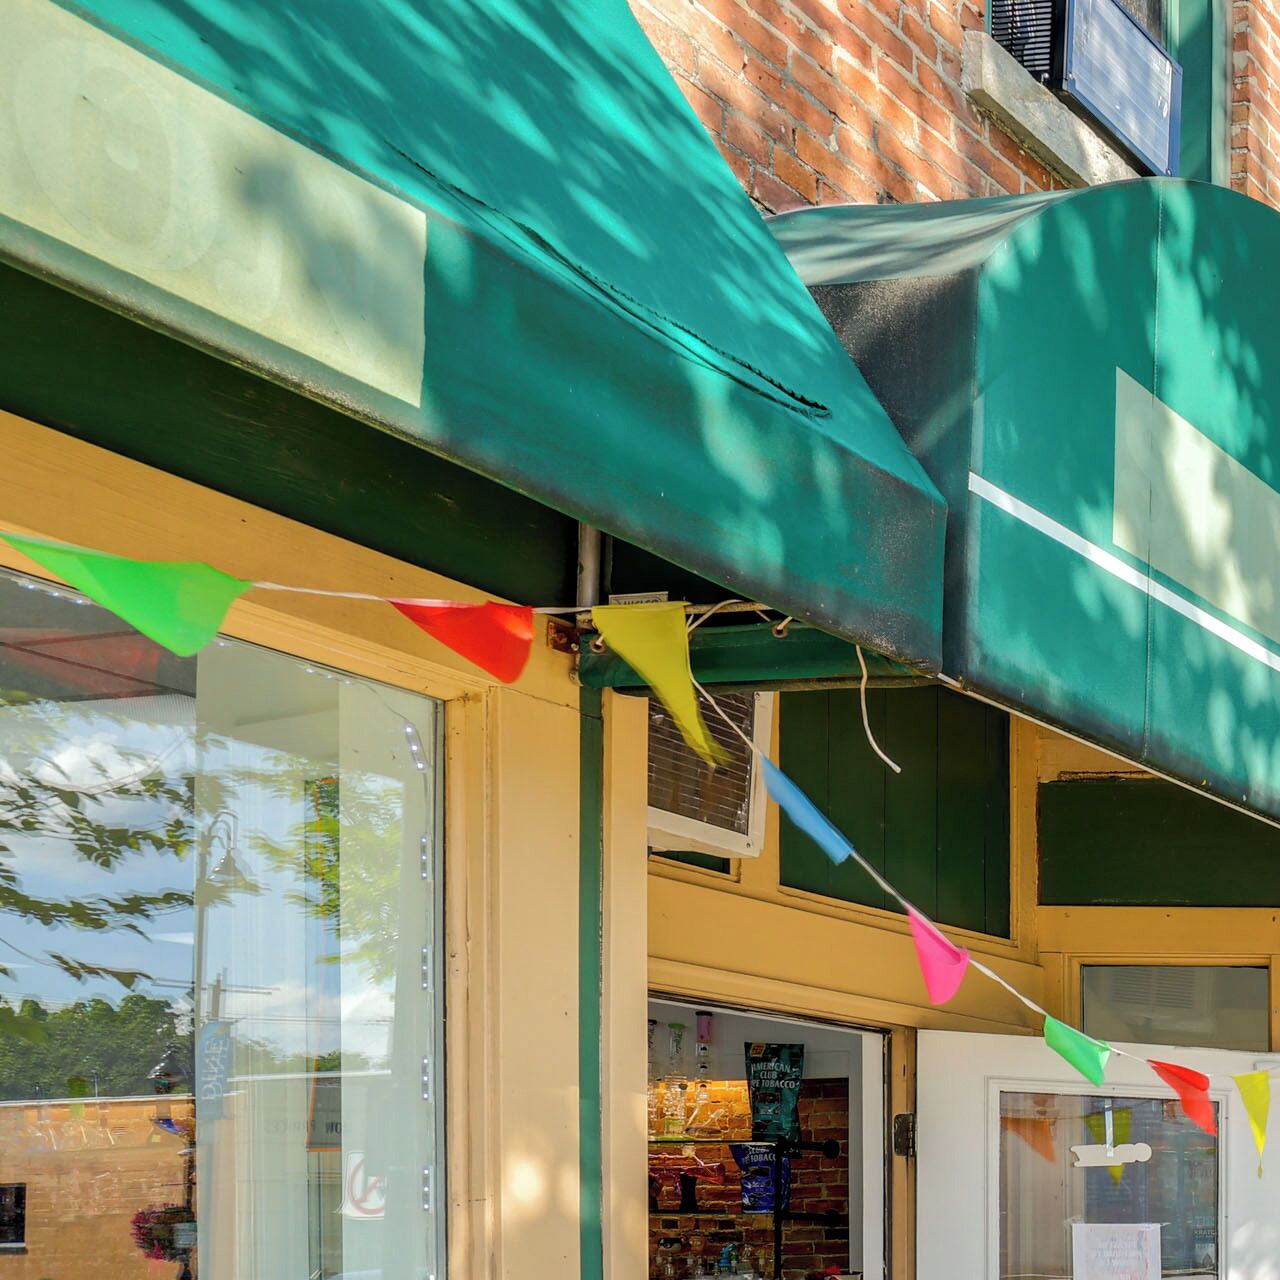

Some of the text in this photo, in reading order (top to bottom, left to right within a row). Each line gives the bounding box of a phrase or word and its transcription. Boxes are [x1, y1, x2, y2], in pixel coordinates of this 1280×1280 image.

[751, 1061, 791, 1073] AMERICAN
[760, 1071, 778, 1080] CLUB
[761, 1080, 796, 1089] TOBACCO
